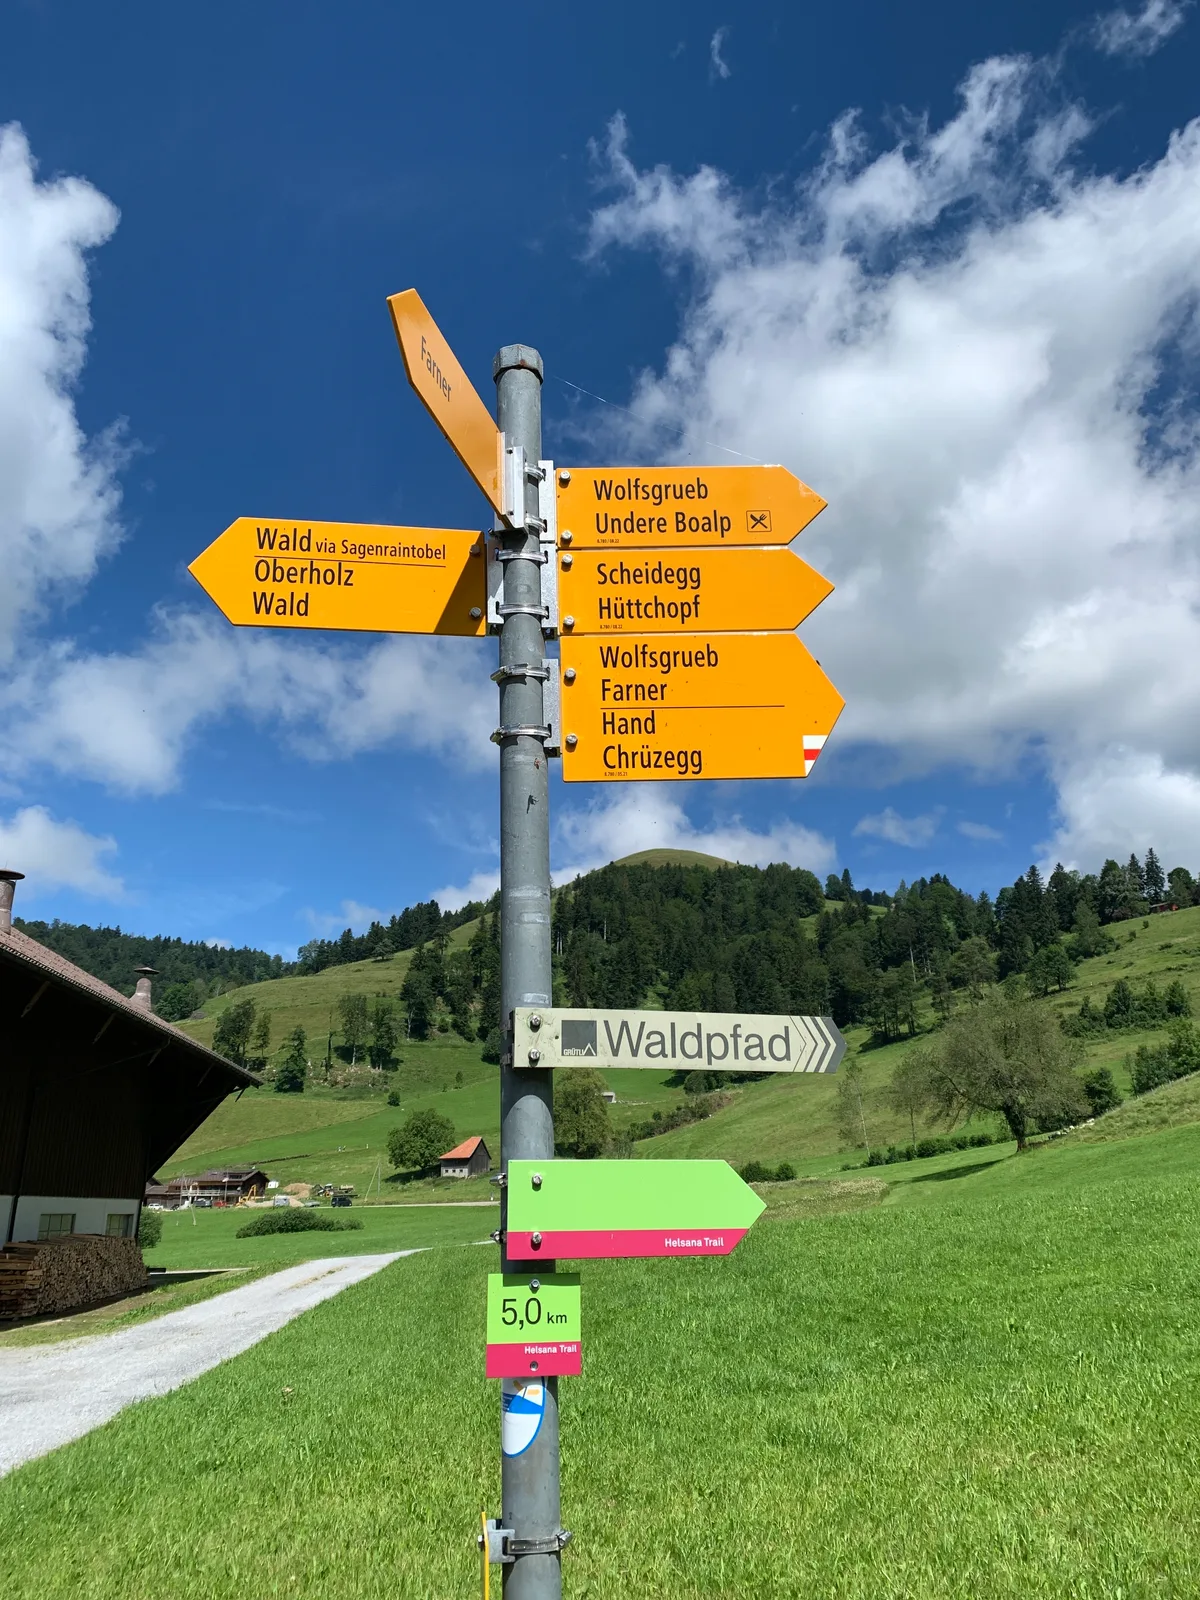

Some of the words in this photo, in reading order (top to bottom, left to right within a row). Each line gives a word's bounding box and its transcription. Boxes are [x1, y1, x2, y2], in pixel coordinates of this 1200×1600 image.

[420, 335, 452, 402] Farner
[594, 477, 709, 506] Wolfsgrueb
[595, 511, 668, 534] Undere
[675, 510, 732, 538] Boalp
[256, 527, 312, 552] Wald
[315, 539, 336, 553] via
[341, 539, 446, 560] Sagenraintobel
[254, 558, 354, 587] Oberholz
[597, 561, 701, 590] Scheidegg
[252, 591, 309, 617] Wald
[598, 594, 700, 624] Hüttchopf
[599, 644, 719, 674] Wolfsgrueb
[601, 679, 668, 702] Farner
[601, 709, 656, 735] Hand
[602, 744, 703, 774] Chrüzegg
[603, 1020, 791, 1065] Waldpfad
[664, 1237, 702, 1248] Helsana
[703, 1237, 724, 1247] Trail
[501, 1297, 542, 1330] 5,0
[547, 1311, 568, 1325] km
[524, 1345, 557, 1355] Helsana
[559, 1344, 578, 1354] Trail
